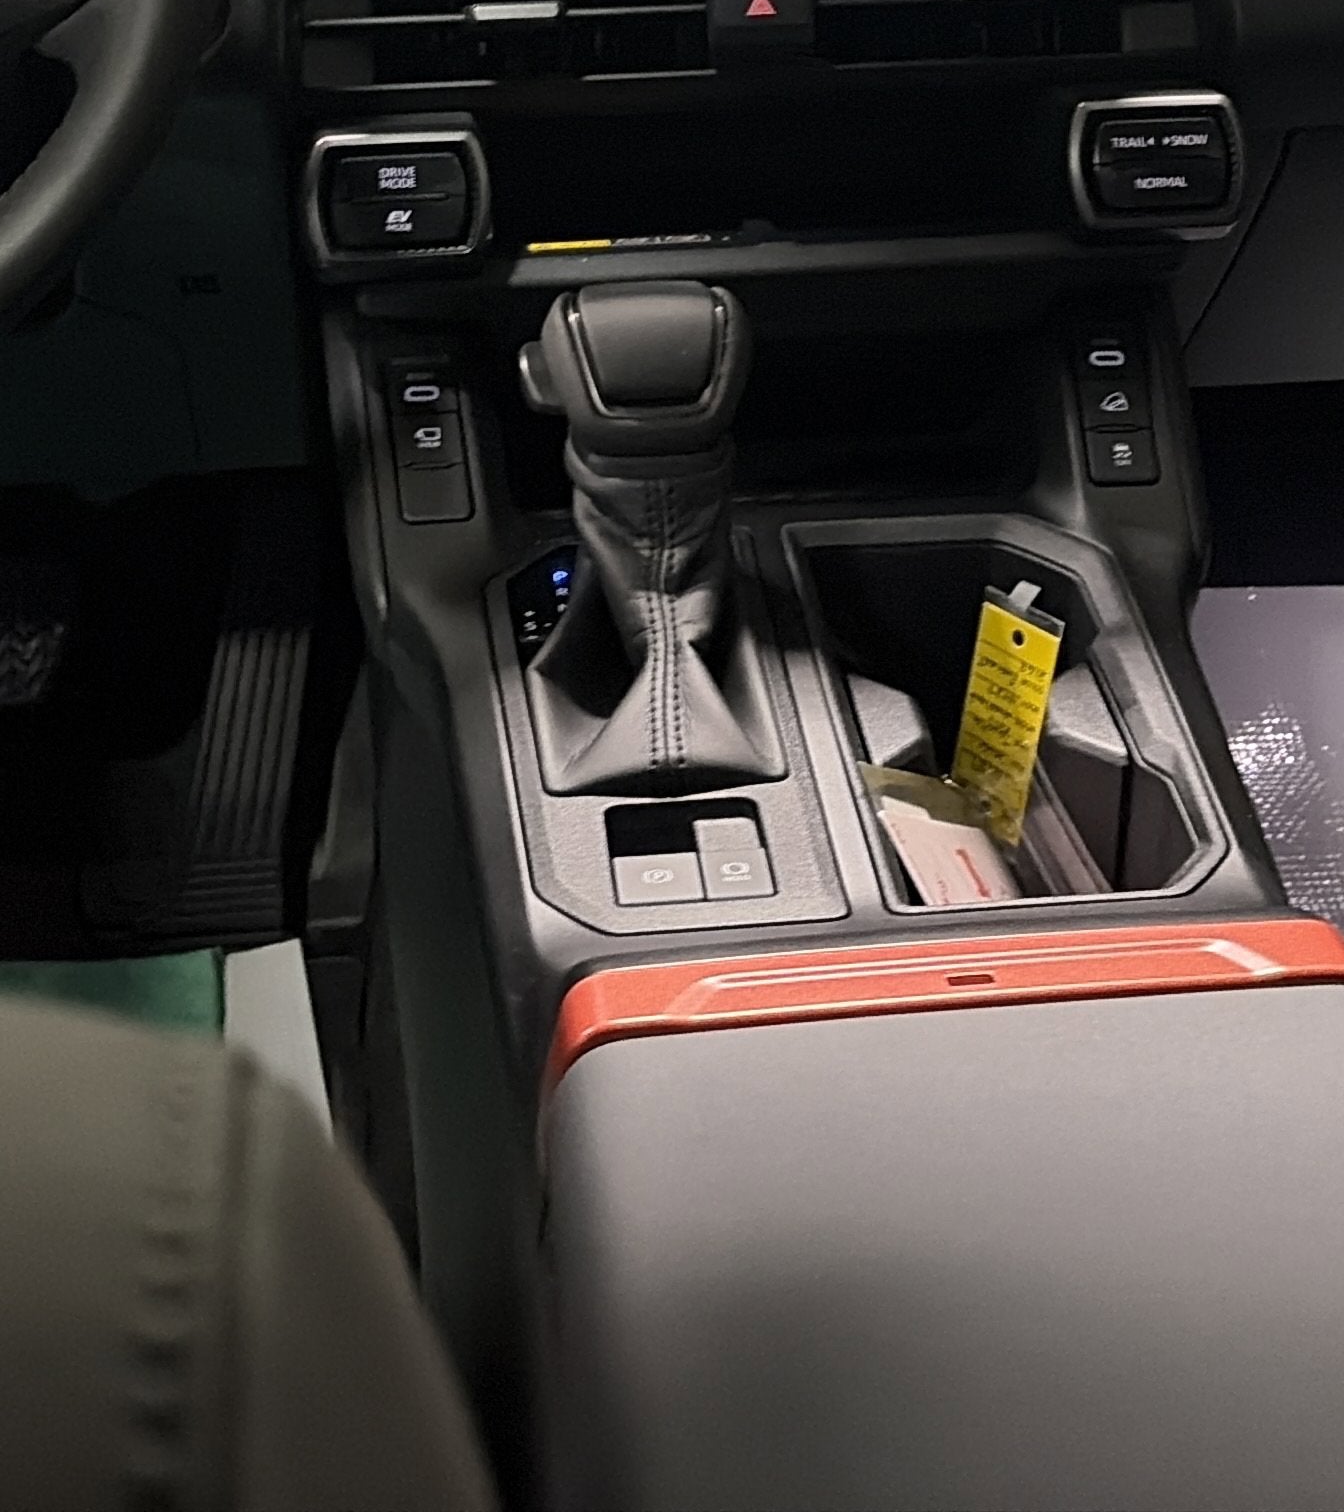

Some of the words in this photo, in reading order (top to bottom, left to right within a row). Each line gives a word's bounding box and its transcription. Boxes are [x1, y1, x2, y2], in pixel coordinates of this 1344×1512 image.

[1109, 137, 1147, 149] TRAIL
[1169, 134, 1209, 147] SNOW
[378, 166, 417, 179] DRIVE
[378, 177, 417, 189] MODE
[1133, 176, 1189, 189] NORMAL
